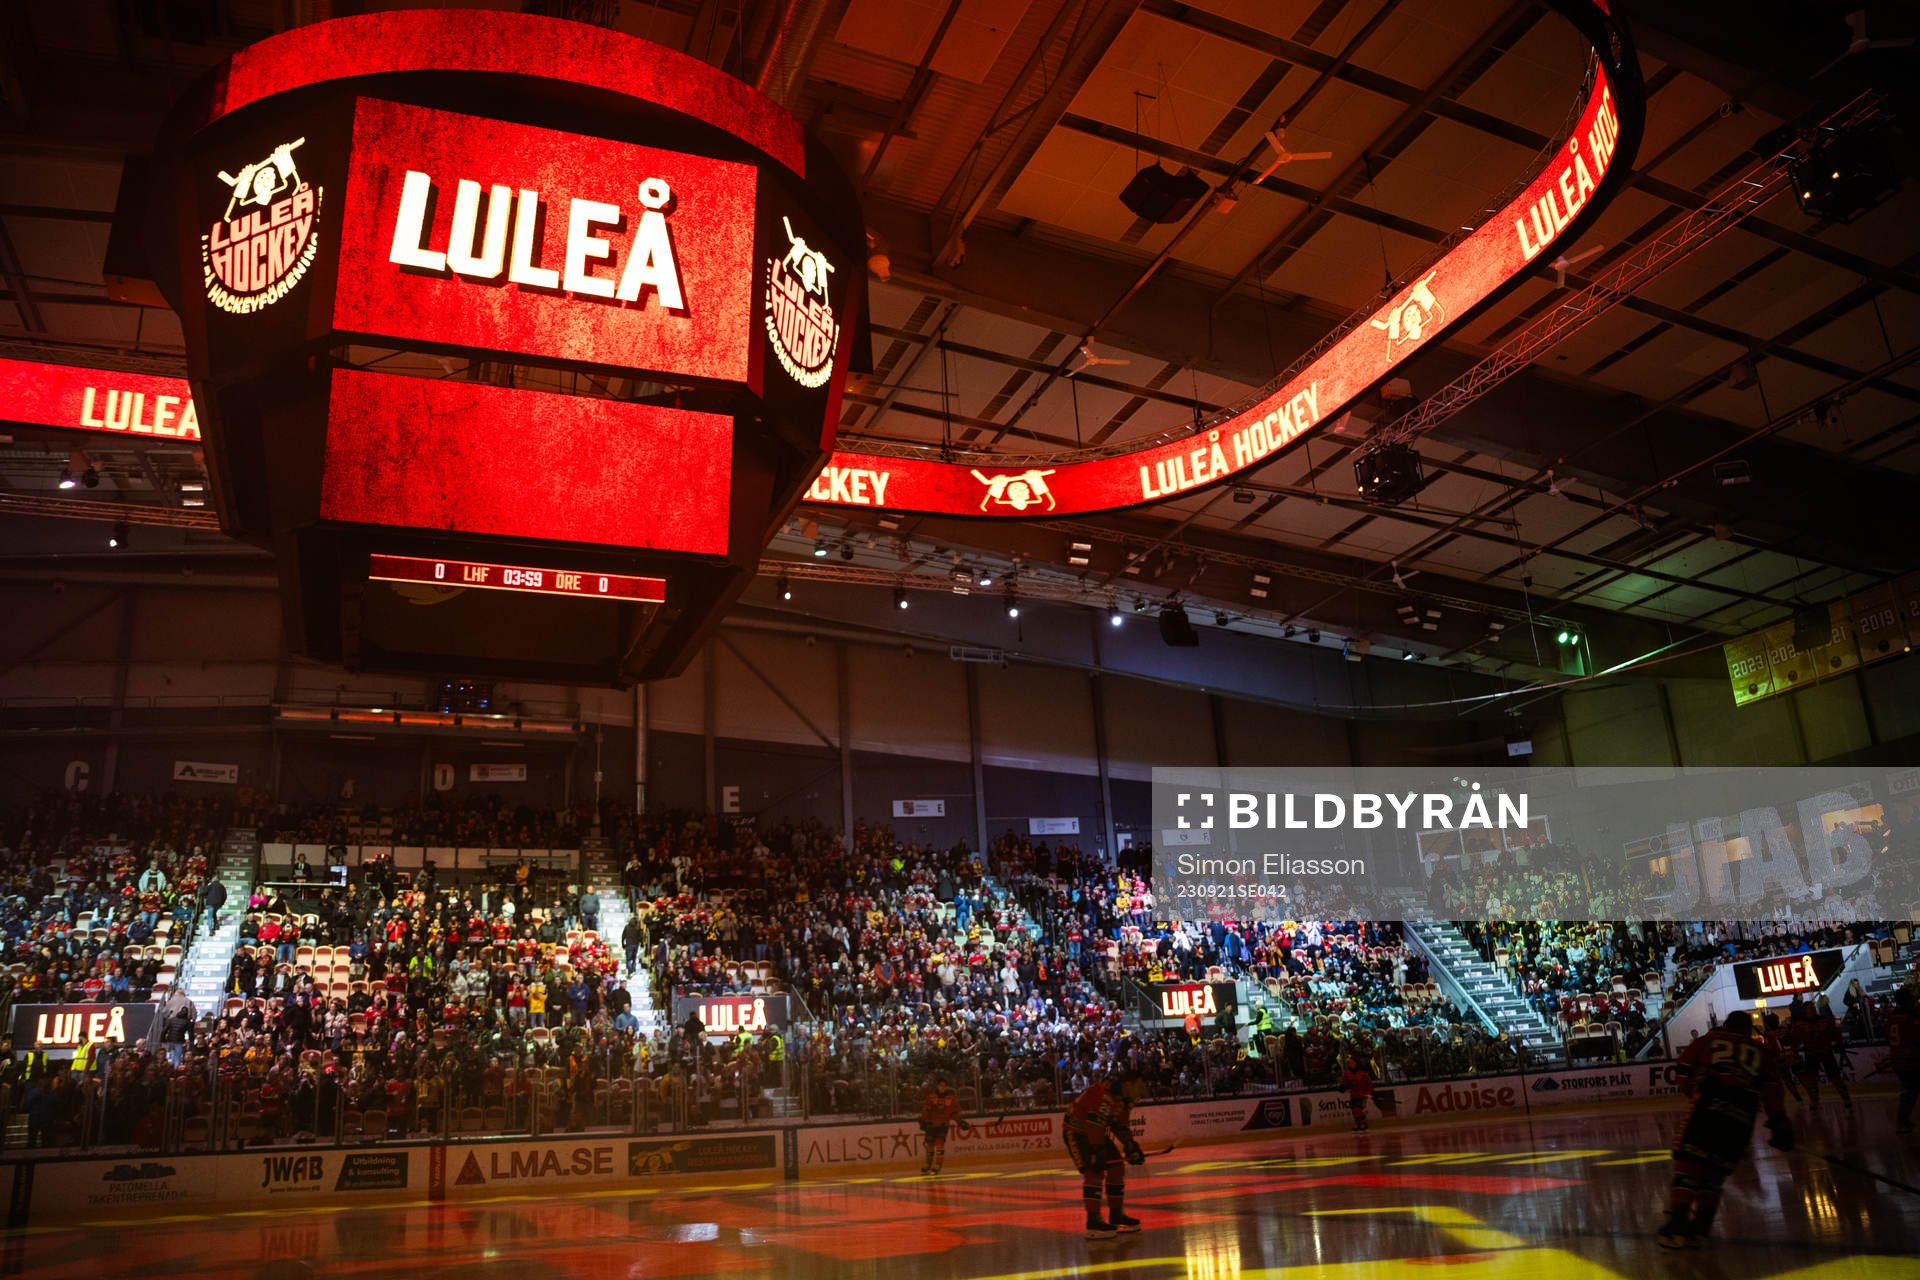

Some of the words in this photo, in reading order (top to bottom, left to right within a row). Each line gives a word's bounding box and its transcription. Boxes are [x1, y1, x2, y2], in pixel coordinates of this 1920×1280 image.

[1515, 137, 1594, 261] LULEÅ
[210, 182, 313, 252] LULEÅ
[210, 214, 313, 292] HOCKEY
[389, 170, 684, 310] LULEÅ
[771, 258, 834, 340] LULEÅ
[771, 284, 832, 368] HOCKEY
[1139, 431, 1230, 500] LULEÅ
[1234, 382, 1323, 465] HOCKEY
[435, 563, 445, 579] 0
[463, 565, 490, 583] LHF
[503, 569, 542, 588] 03:59
[599, 577, 608, 593] 0
[1860, 608, 1896, 634] 2019
[1731, 655, 1766, 679] 2023
[64, 760, 91, 792] C
[722, 786, 741, 813] E
[1756, 955, 1820, 993] LULEÅ
[699, 998, 767, 1032] LULEÅ
[1162, 985, 1217, 1016] LULEÅ
[37, 1006, 125, 1045] LULEÅ
[1610, 1071, 1632, 1086] PLÅT
[1415, 1082, 1515, 1115] Advise
[988, 1120, 1049, 1137] KVANTUM
[262, 1156, 324, 1188] JWAB
[490, 1147, 613, 1180] LMA.SE
[109, 1181, 168, 1193] PATOMELLA
